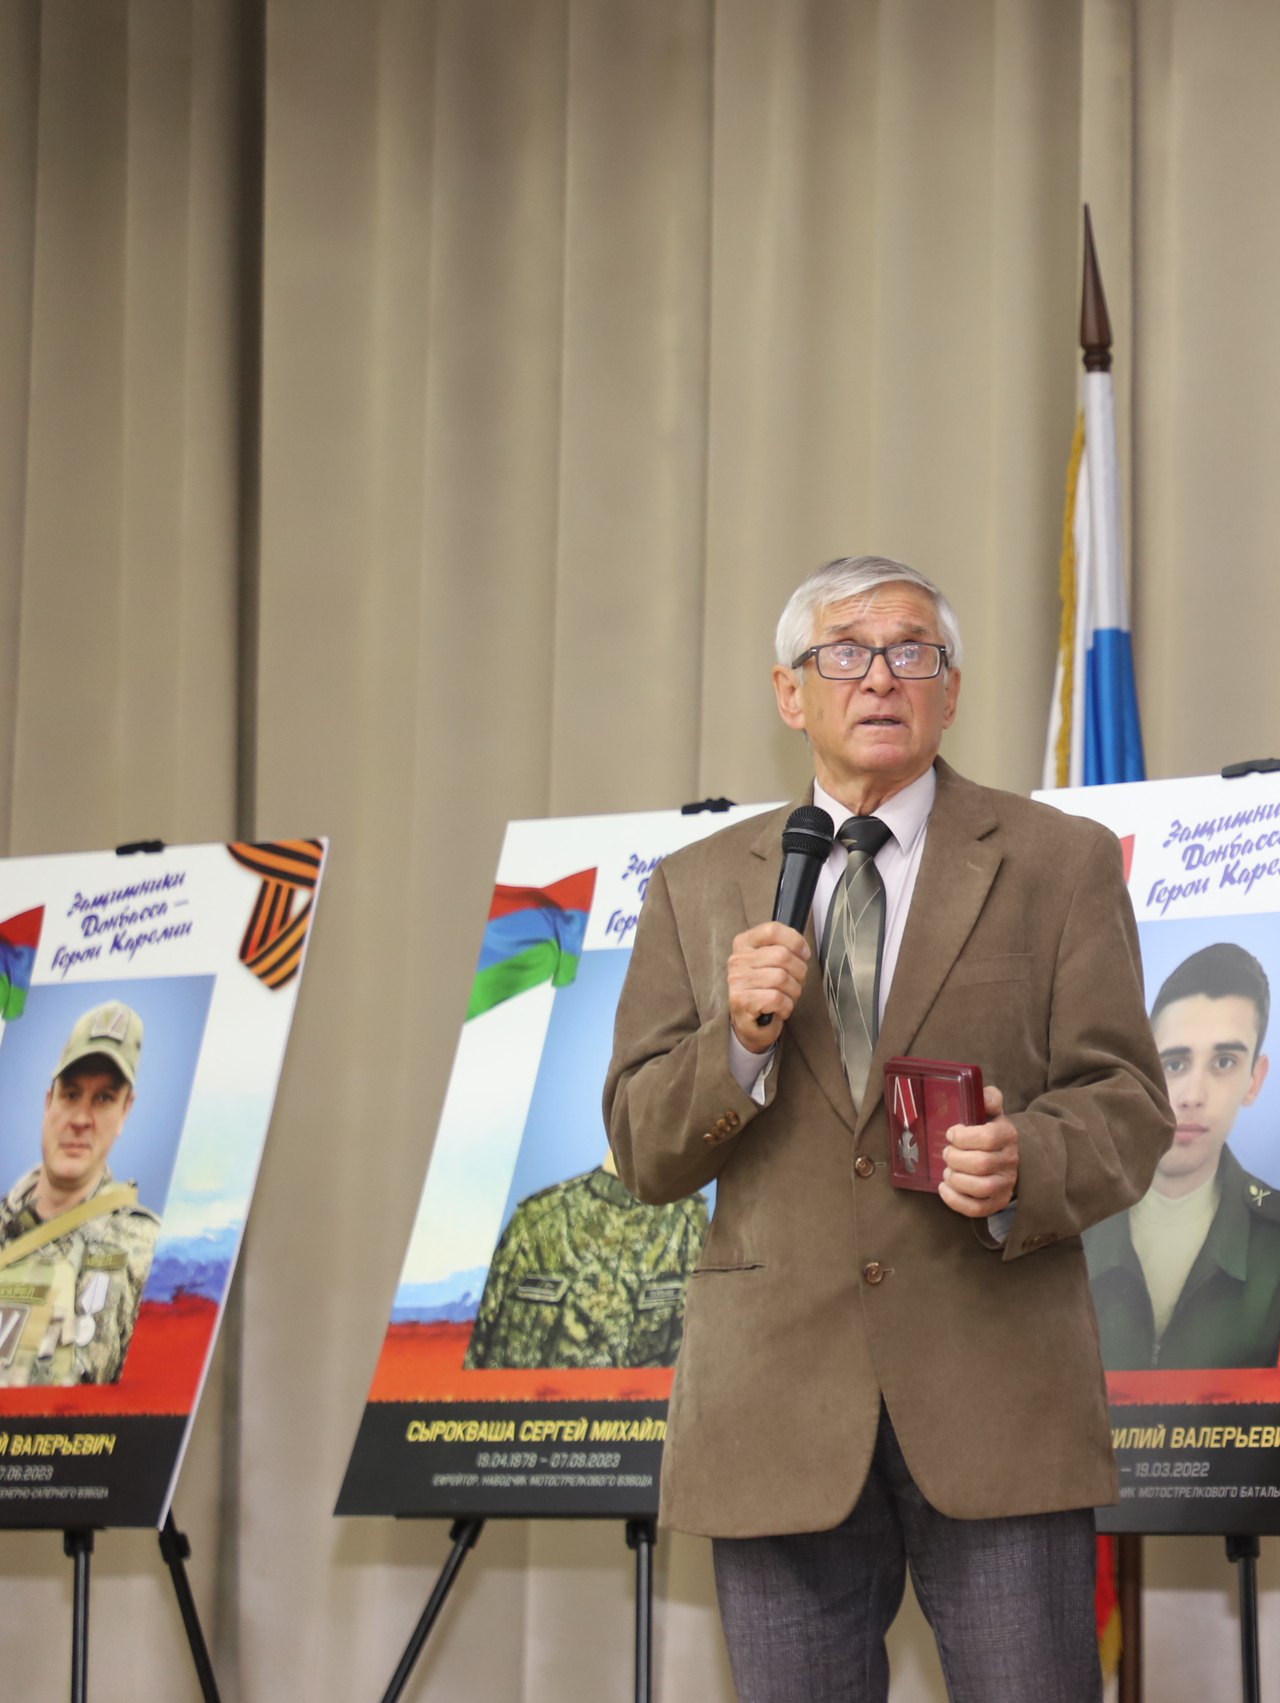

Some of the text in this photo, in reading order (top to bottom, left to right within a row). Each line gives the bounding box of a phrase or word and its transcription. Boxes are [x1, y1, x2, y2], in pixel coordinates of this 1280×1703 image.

[67, 873, 186, 916] Защитники
[1146, 877, 1210, 917] Герои
[81, 903, 167, 938] Донбасса
[51, 920, 194, 980] Герои Карелии
[406, 1417, 667, 1443] СЫРОКВАША СЕРГЕЙ МИХАЙЛ
[1111, 1424, 1166, 1449] ИЛИЙ
[11, 1433, 117, 1457] ВАЛЕРЬЕВИЧ
[1134, 1462, 1210, 1478] 19.03.2022
[1138, 1486, 1238, 1498] МОТОСТРЕЛКОВОГО
